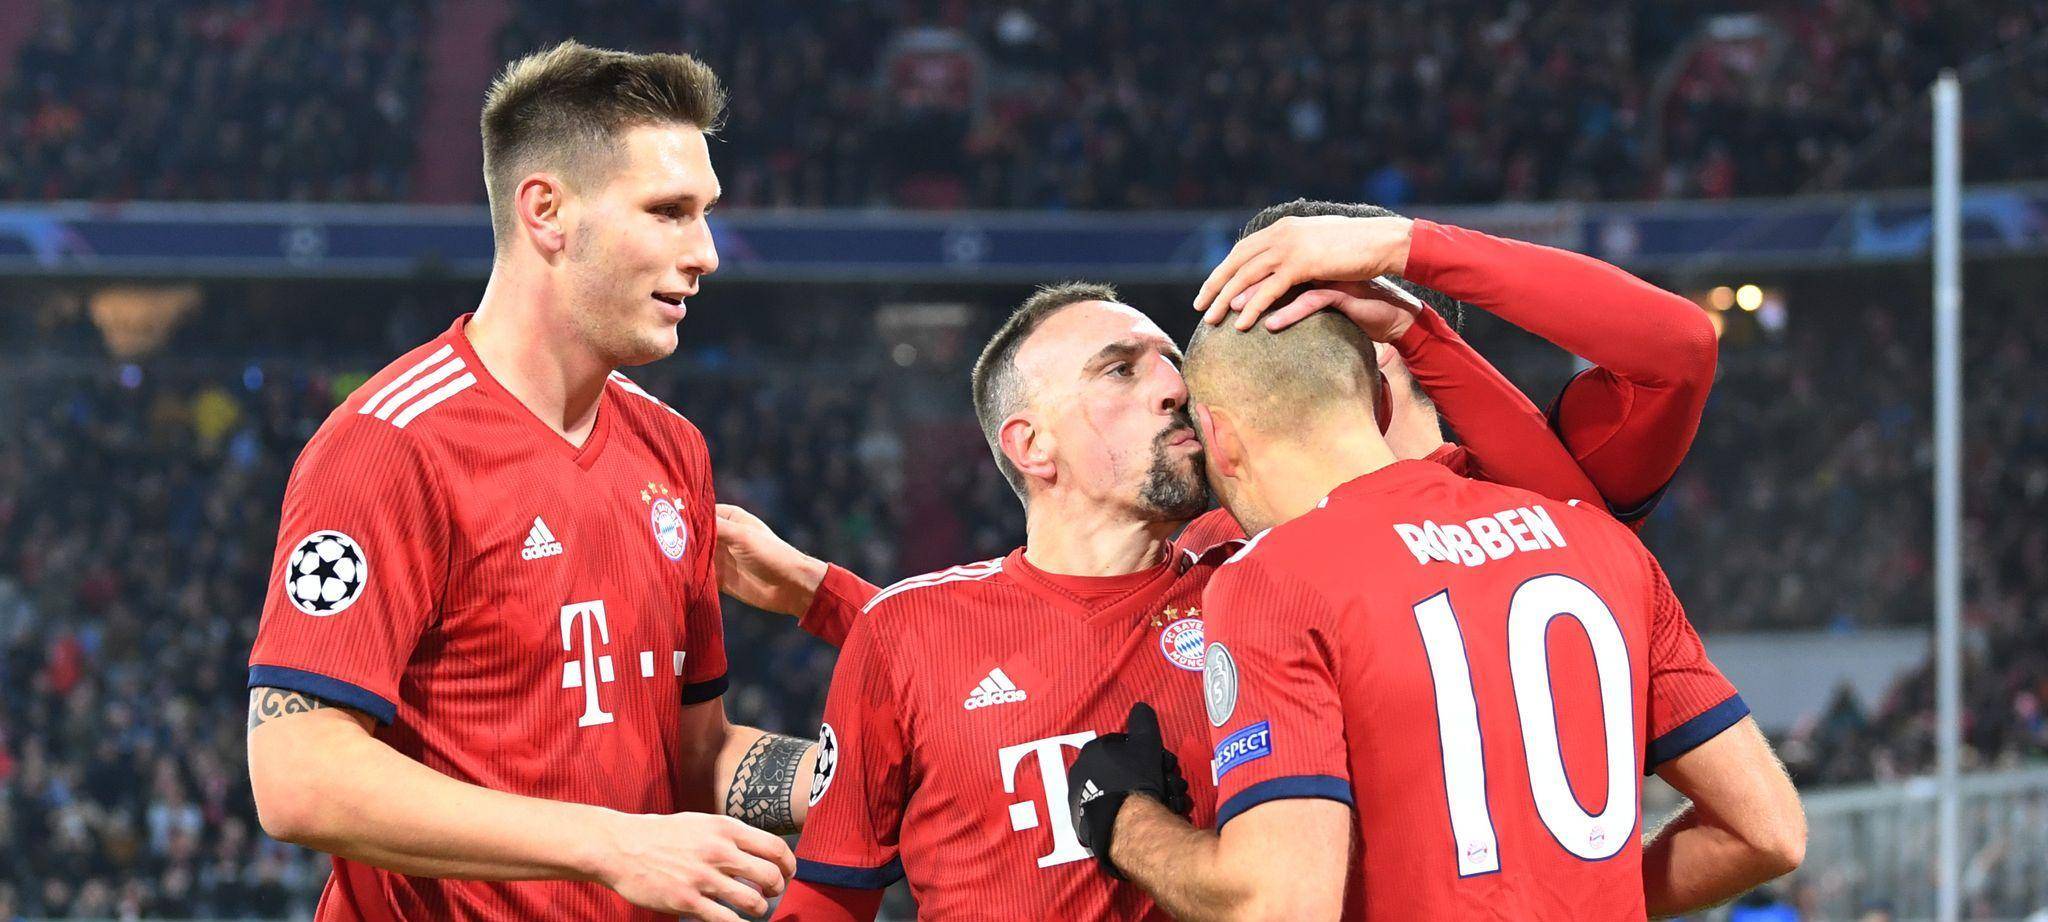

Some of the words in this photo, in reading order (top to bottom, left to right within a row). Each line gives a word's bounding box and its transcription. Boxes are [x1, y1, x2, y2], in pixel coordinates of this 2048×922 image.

[1393, 505, 1567, 567] ROBBEN
[521, 541, 563, 560] adidas
[1173, 621, 1204, 633] BAYE
[963, 689, 1027, 711] adidas
[1412, 573, 1638, 878] 10
